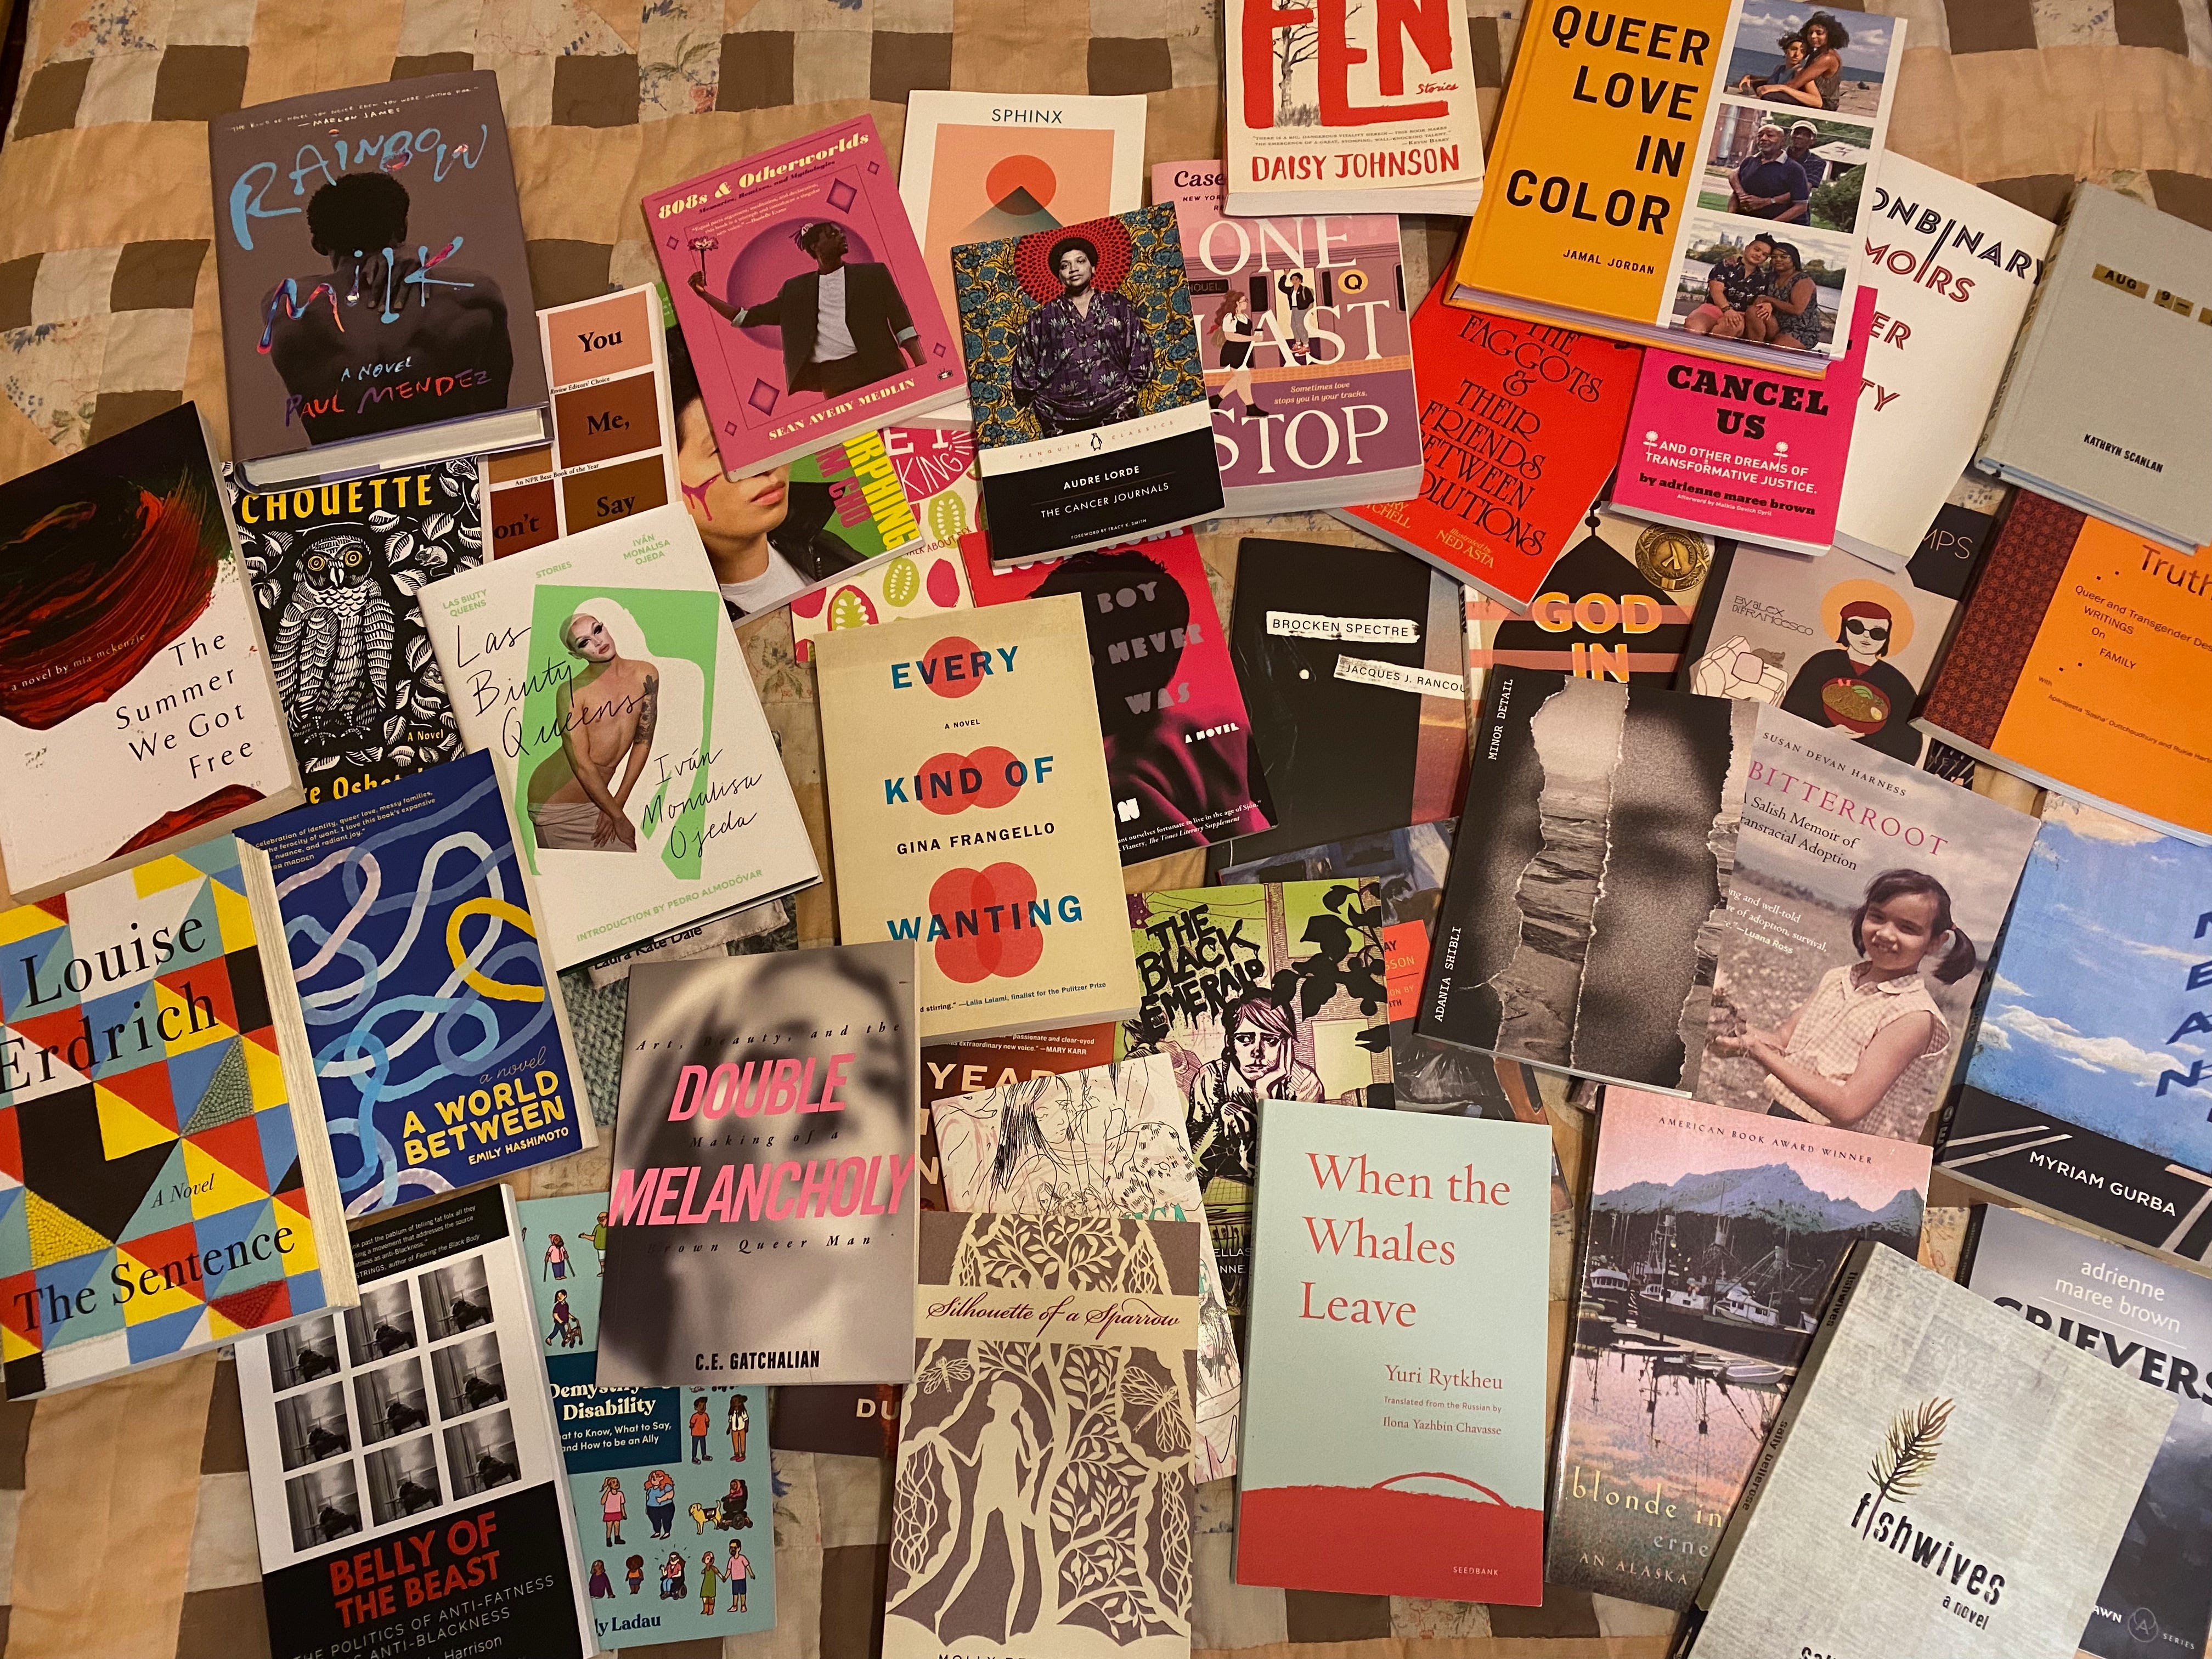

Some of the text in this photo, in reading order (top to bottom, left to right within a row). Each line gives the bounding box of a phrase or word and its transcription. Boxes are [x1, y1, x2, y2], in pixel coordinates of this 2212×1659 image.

[1551, 4, 1712, 67] QUEER
[1415, 82, 1458, 95] Stories
[1571, 64, 1700, 122] LOVE
[991, 108, 1063, 124] SPHINX
[658, 194, 708, 218] 808s
[714, 182, 731, 198] &
[738, 133, 868, 188] Otherworlds
[1252, 144, 1459, 182] DAISY JOHNSON
[1634, 133, 1686, 178] IN
[1506, 169, 1671, 236] COLOR
[1562, 248, 1656, 276] JAMAL JORDAN
[577, 330, 623, 353] You
[285, 369, 493, 427] PAUL MENDEZ
[1274, 396, 1295, 405] stops
[1296, 394, 1311, 403] you
[1321, 392, 1340, 402] your
[1341, 390, 1368, 398] tracks.
[1290, 381, 1350, 393] Sometimes love
[1666, 364, 1829, 416] CANCEL
[586, 411, 630, 436] Me,
[768, 378, 916, 441] SEAN AVERY MEDLIN
[1717, 408, 1766, 439] US
[1019, 421, 1175, 460] PENGUIN CLASSICS
[1659, 441, 1809, 477] AND OTHER DREAMS OF
[2083, 433, 2164, 473] KATHRYN SCANLAN
[524, 476, 539, 484] NPR
[539, 473, 552, 482] Best
[554, 471, 568, 479] Book
[585, 463, 600, 472] Year
[1063, 465, 1141, 490] AUDRE LORDE
[1639, 472, 1816, 515] by adrienne maree brown
[1646, 452, 1817, 494] TRANSFORMATIVE JUSTICE.
[1040, 482, 1170, 518] THE CANCER JOURNALS
[1071, 529, 1100, 539] FOREWORD
[1108, 523, 1124, 531] TRACY
[1131, 518, 1147, 527] SMITH
[1436, 530, 1493, 568] NED ASTA
[535, 561, 573, 579] STORIES
[442, 588, 488, 611] LAS BIUTY
[449, 599, 487, 618] QUEENS
[1097, 581, 1158, 614] BOY
[1532, 591, 1663, 634] GOD
[2075, 584, 2192, 644] Queer and Transgender
[1272, 618, 1409, 637] BROCKEN SPECTRE
[2084, 606, 2135, 635] WRITINGS
[10, 632, 146, 692] a novel by mia mckenzie
[167, 630, 227, 668] The
[1107, 623, 1205, 665] NEVER
[2098, 647, 2137, 670] FAMILY
[890, 645, 1019, 690] EVERY
[1346, 664, 1413, 683] JACQUES J.
[115, 668, 237, 731] Summer
[1124, 682, 1191, 715] WAS
[1487, 678, 1514, 761] MINOR DETAIL
[127, 702, 246, 763] We Got
[189, 740, 255, 780] Free
[884, 755, 1055, 805] KIND OF
[1762, 731, 1908, 797] SUSAN DEVAN HARNESS
[1748, 760, 1949, 856] BITTERROOT
[1750, 795, 1861, 850] Salish Memoir of
[896, 822, 1056, 855] GINA FRANGELLO
[575, 907, 651, 943] INTRODUCTION
[652, 902, 666, 915] BY
[666, 891, 701, 909] PEDRO
[887, 894, 1084, 943] WANTING
[19, 915, 207, 1008] Louise
[1433, 926, 1462, 1024] ADANIA SHIBLI
[402, 1069, 561, 1139] A WORLD
[667, 1052, 856, 1123] DOUBLE
[403, 1096, 566, 1167] BETWEEN
[467, 1126, 570, 1166] EMILY HASHIMOTO
[1657, 1115, 1874, 1166] AMERICAN BOOK AWARD WINNER
[607, 1152, 916, 1228] MELANCHOLY
[1304, 1151, 1511, 1208] When the
[2029, 1150, 2178, 1218] MYRIAM GURBA
[1301, 1215, 1457, 1268] Whales
[13, 1222, 296, 1334] The Sentence
[2080, 1261, 2165, 1301] adrienne
[926, 1290, 1180, 1342] Silhouette of a Sparrow
[1297, 1279, 1418, 1329] Leave
[2055, 1278, 2181, 1333] maree brown
[694, 1348, 821, 1371] C.E. GATCHALIAN
[1384, 1363, 1503, 1390] Yuri Rytkheu
[563, 1396, 656, 1420] Disability
[1385, 1396, 1423, 1407] Translated
[1426, 1399, 1444, 1408] from
[1463, 1402, 1489, 1410] Russian
[1493, 1404, 1502, 1413] by
[1383, 1417, 1502, 1435] Ilona Yazhbin Chavasse
[329, 1509, 498, 1599] BELLY OF
[1452, 1565, 1500, 1578] SEEDBANK
[334, 1550, 501, 1629] THE BEAST
[330, 1575, 554, 1654] POLITICS OF ANTI-FATNESS
[610, 1612, 662, 1633] Ladau
